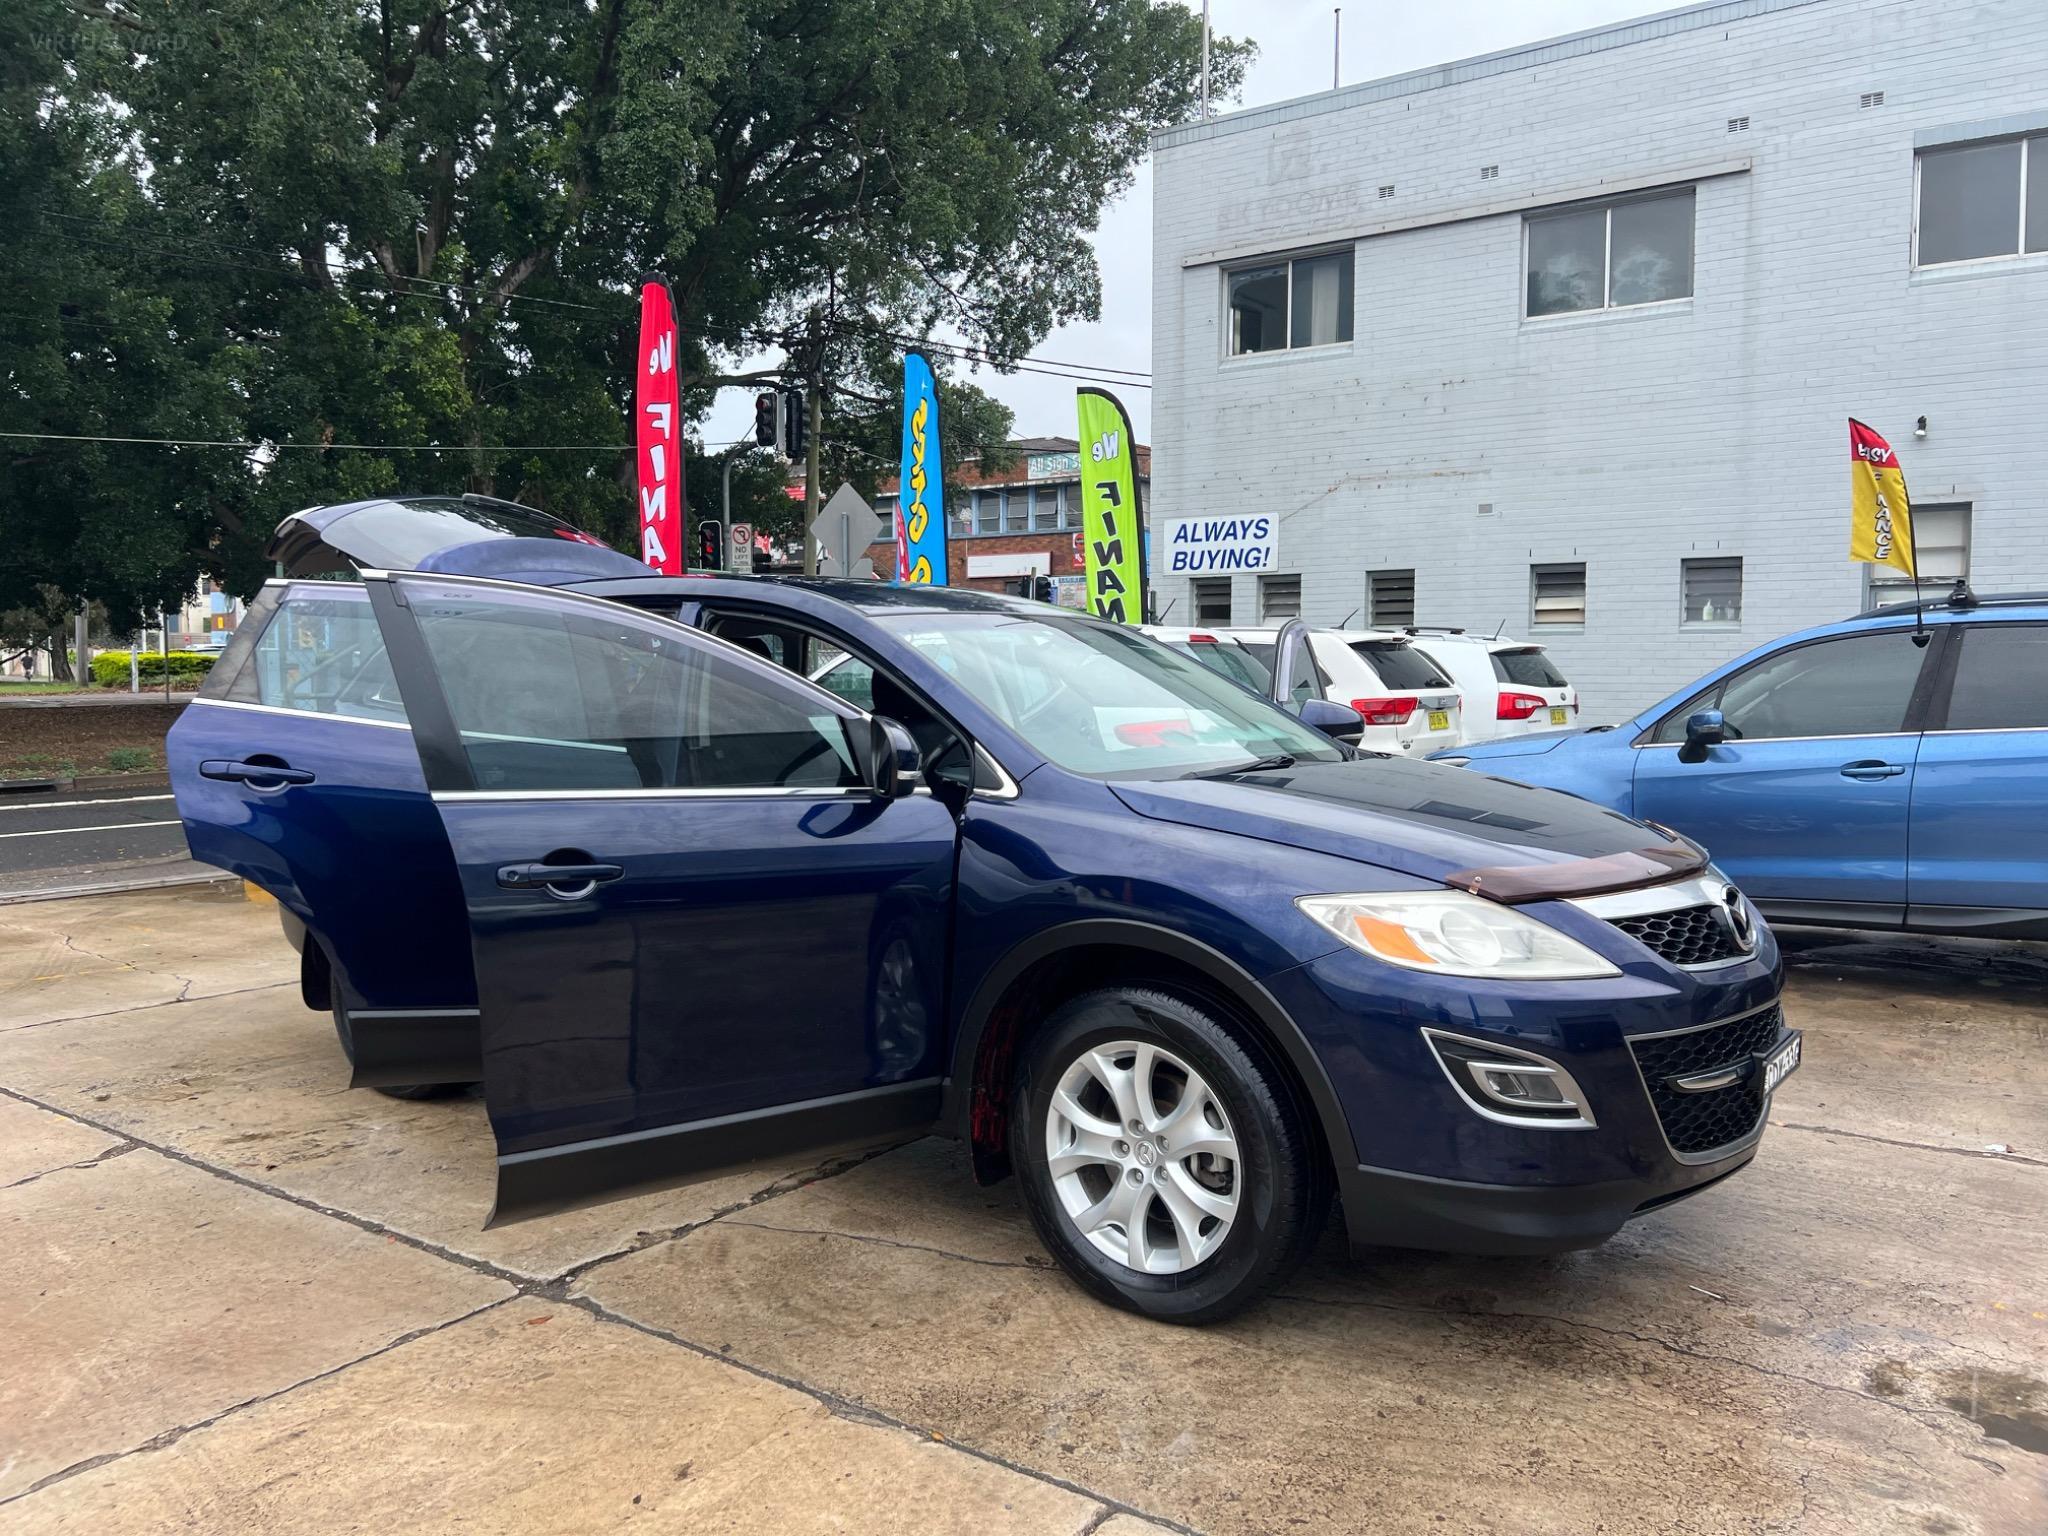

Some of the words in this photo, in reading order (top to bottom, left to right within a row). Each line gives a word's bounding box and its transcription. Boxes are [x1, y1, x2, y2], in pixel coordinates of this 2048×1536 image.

[1031, 457, 1044, 472] All
[1046, 456, 1069, 472] Sign
[1071, 454, 1081, 470] S
[1173, 518, 1270, 544] ALWAYS
[1172, 547, 1271, 571] BUYING!
